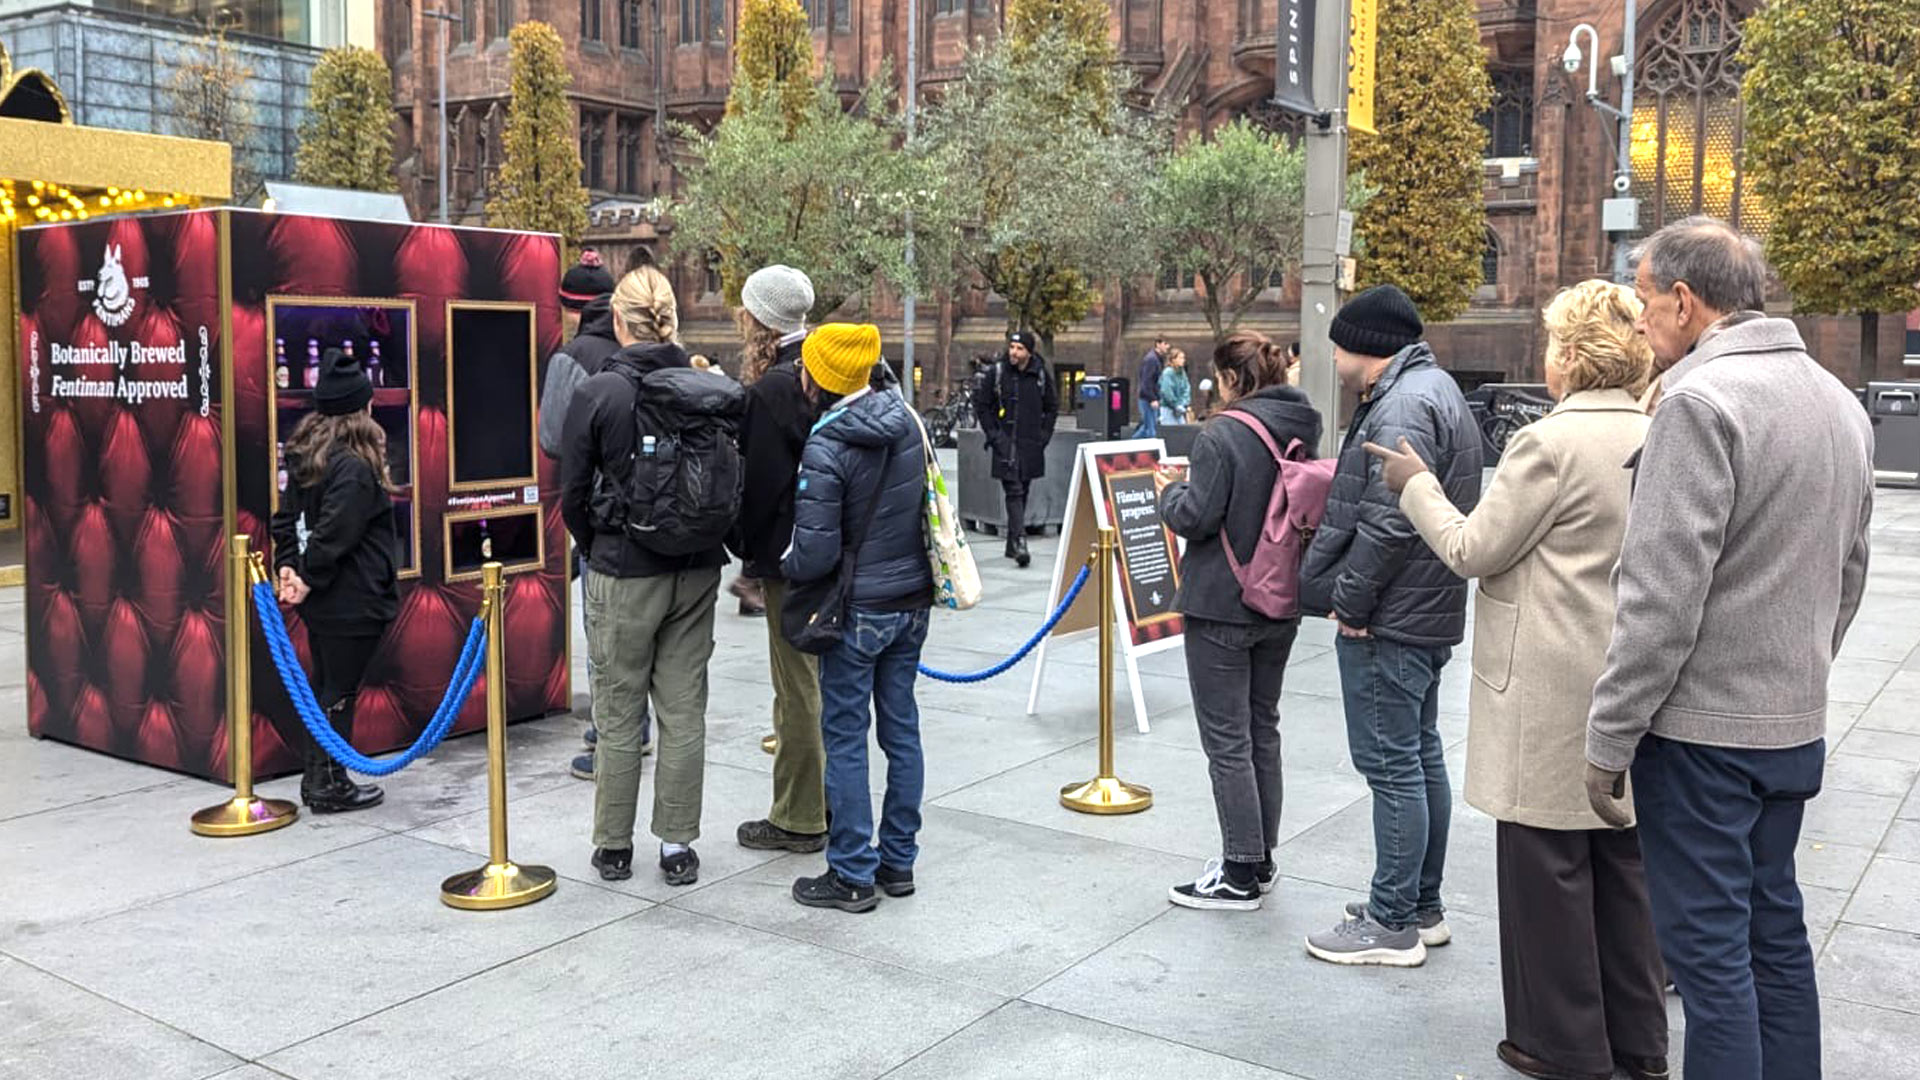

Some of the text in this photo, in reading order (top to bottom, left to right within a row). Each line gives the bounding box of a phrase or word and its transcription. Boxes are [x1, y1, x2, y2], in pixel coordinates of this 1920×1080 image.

[1289, 0, 1298, 85] SPIN
[51, 340, 186, 369] Botanically Brewed
[51, 374, 188, 404] Fentiman Approved
[1115, 488, 1155, 504] Filming in
